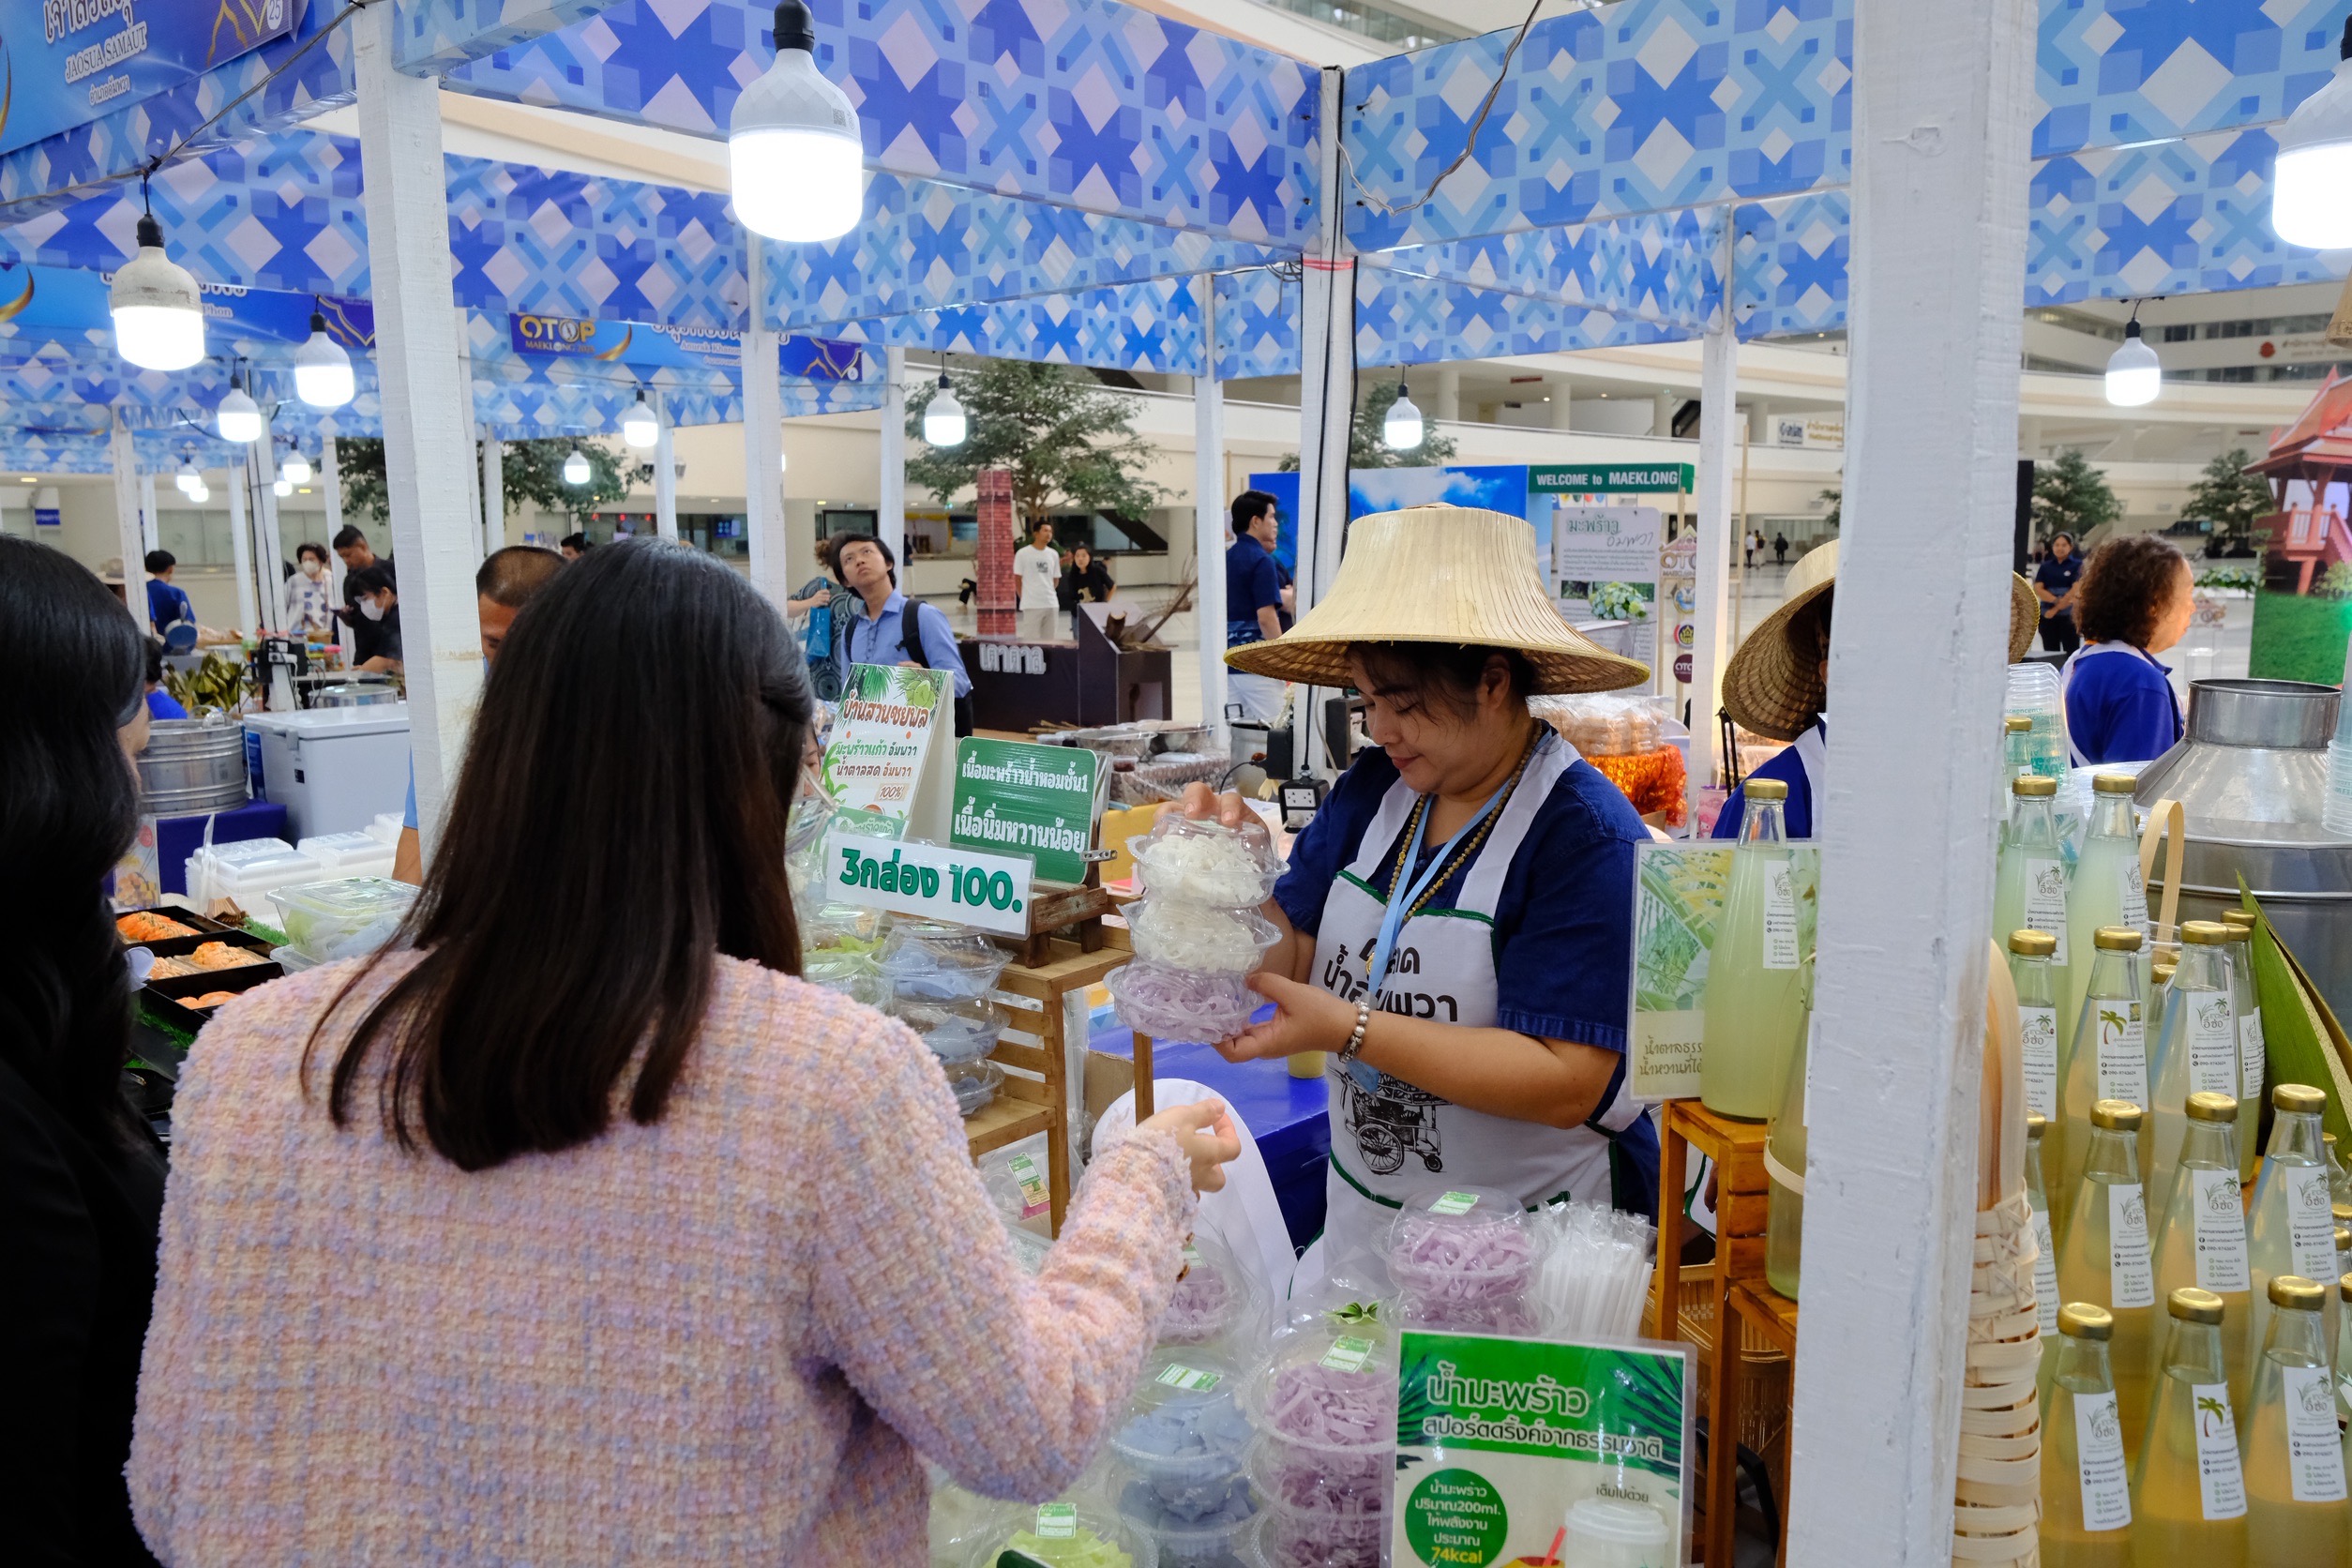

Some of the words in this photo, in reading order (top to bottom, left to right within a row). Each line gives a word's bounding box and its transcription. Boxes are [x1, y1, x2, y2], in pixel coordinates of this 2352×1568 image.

[268, 2, 281, 22] 25
[66, 48, 104, 79] JAOSUA
[105, 26, 146, 62] SAMAUT
[519, 316, 596, 342] OTOP
[1536, 475, 1588, 486] WELCOME
[1592, 475, 1603, 486] to
[1608, 471, 1679, 485] MAEKLONG
[1568, 514, 1621, 535] มะพร้าว
[1660, 552, 1696, 570] OT
[979, 643, 1047, 675] เตาตาล
[1675, 662, 1693, 671] OTO
[835, 739, 888, 757] มะพร้าวแก้ว
[888, 741, 918, 757] อัมพวา
[837, 756, 881, 777] น้ำตาลสด
[882, 761, 912, 777] อัมพวา
[962, 750, 1088, 792] เนื้อมะพร้าวน้ำหอมชั้น1
[879, 786, 904, 799] 100%
[954, 796, 1087, 853] เนื้อนิ่มหวานน้อย
[839, 848, 940, 898] 3กล่อง
[948, 863, 1022, 913] 100.
[1428, 1361, 1589, 1416] น้ำมะพร้าว
[1424, 1413, 1663, 1458] สปอร์ตดริ้งค์จากธรรมชาติ
[1429, 1479, 1488, 1498] น้ำมะพร้าว
[1596, 1484, 1649, 1503] เต็มไปด้วย
[1426, 1512, 1488, 1531] ให้พลังงาน
[1433, 1532, 1481, 1547] ประมาณ
[1431, 1545, 1483, 1564] 74kcal
